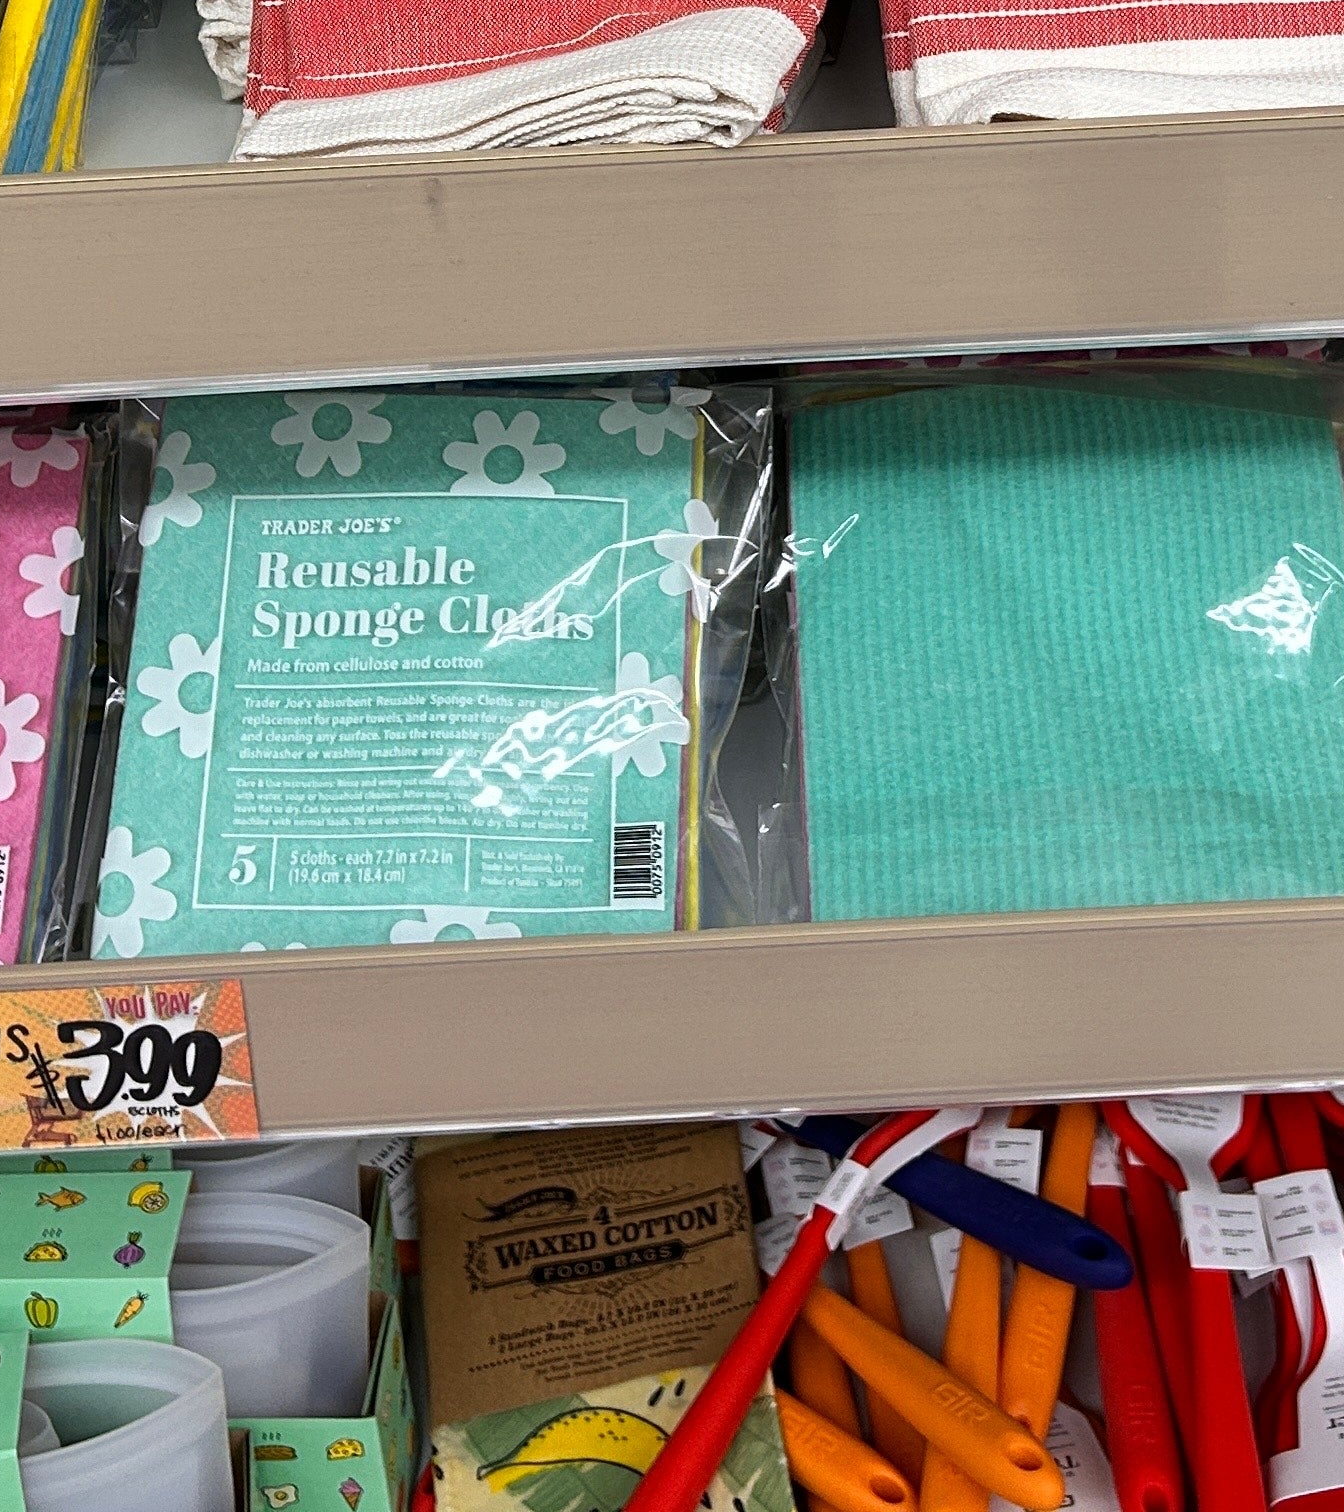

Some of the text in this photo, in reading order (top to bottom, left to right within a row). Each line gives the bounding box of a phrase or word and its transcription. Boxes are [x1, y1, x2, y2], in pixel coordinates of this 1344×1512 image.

[106, 995, 146, 1019] YOU
[25, 1020, 222, 1115] $3.99
[593, 1205, 611, 1225] 4
[494, 1202, 718, 1270] WAXED COTTON
[544, 1245, 673, 1280] FOOD BAGS
